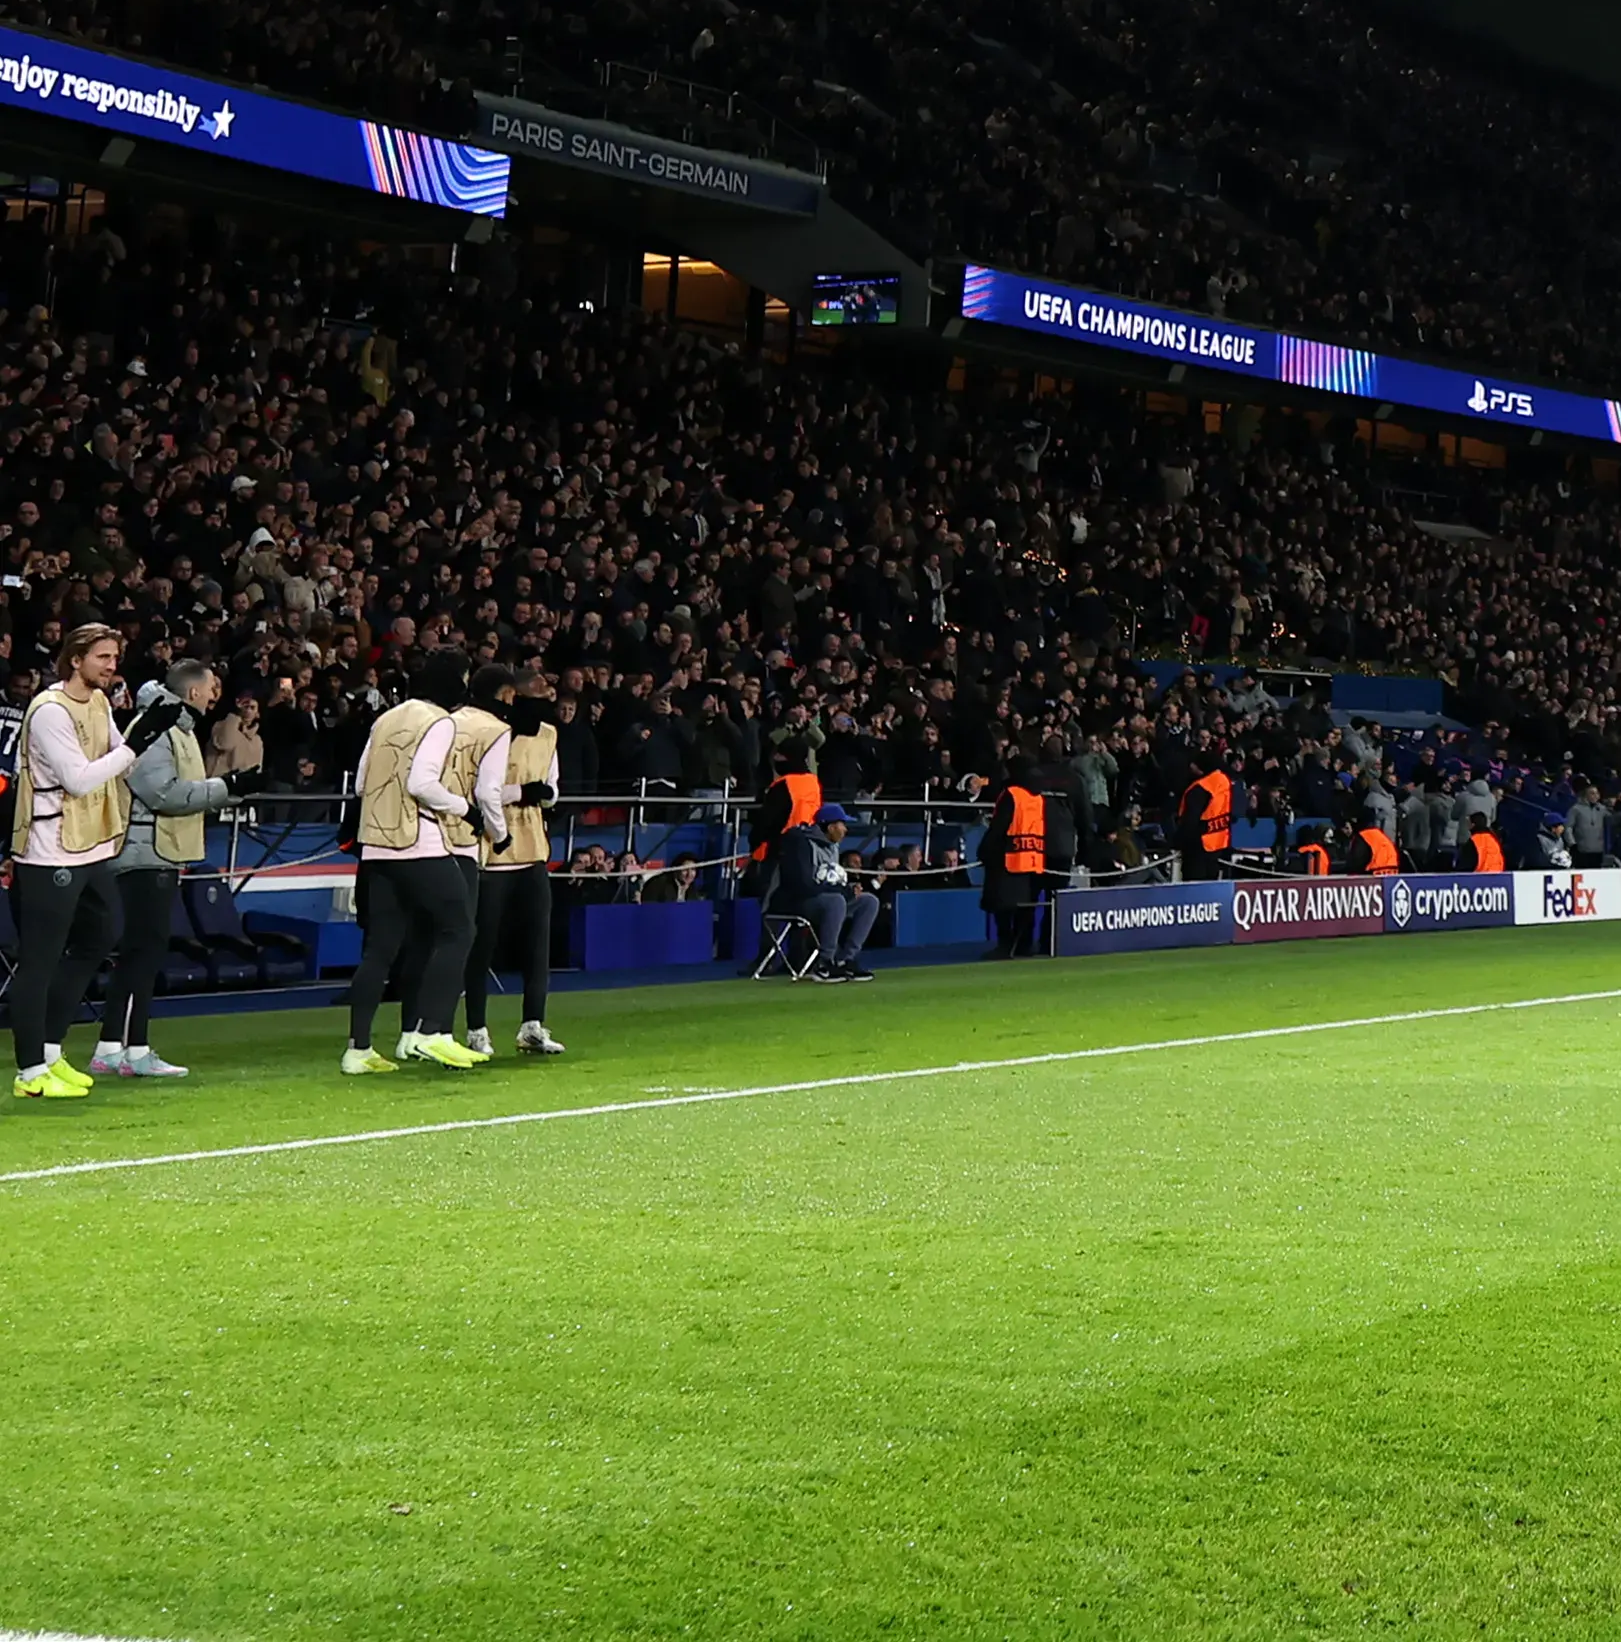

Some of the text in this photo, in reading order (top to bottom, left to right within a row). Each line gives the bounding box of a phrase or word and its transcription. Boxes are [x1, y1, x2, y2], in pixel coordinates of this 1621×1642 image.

[0, 54, 201, 133] njoy responsibly
[491, 112, 749, 196] PARIS SAINT-GERMAIN
[1024, 289, 1256, 365] UEFA CHAMPIONS LEAGUE
[1489, 388, 1534, 417] PS5
[1072, 902, 1220, 934] UEFA CHAMPIONS LEAGUE
[1233, 884, 1384, 931] QATAR AIRWAYS
[1415, 881, 1509, 921] crypto.com
[1543, 874, 1597, 918] FedEx
